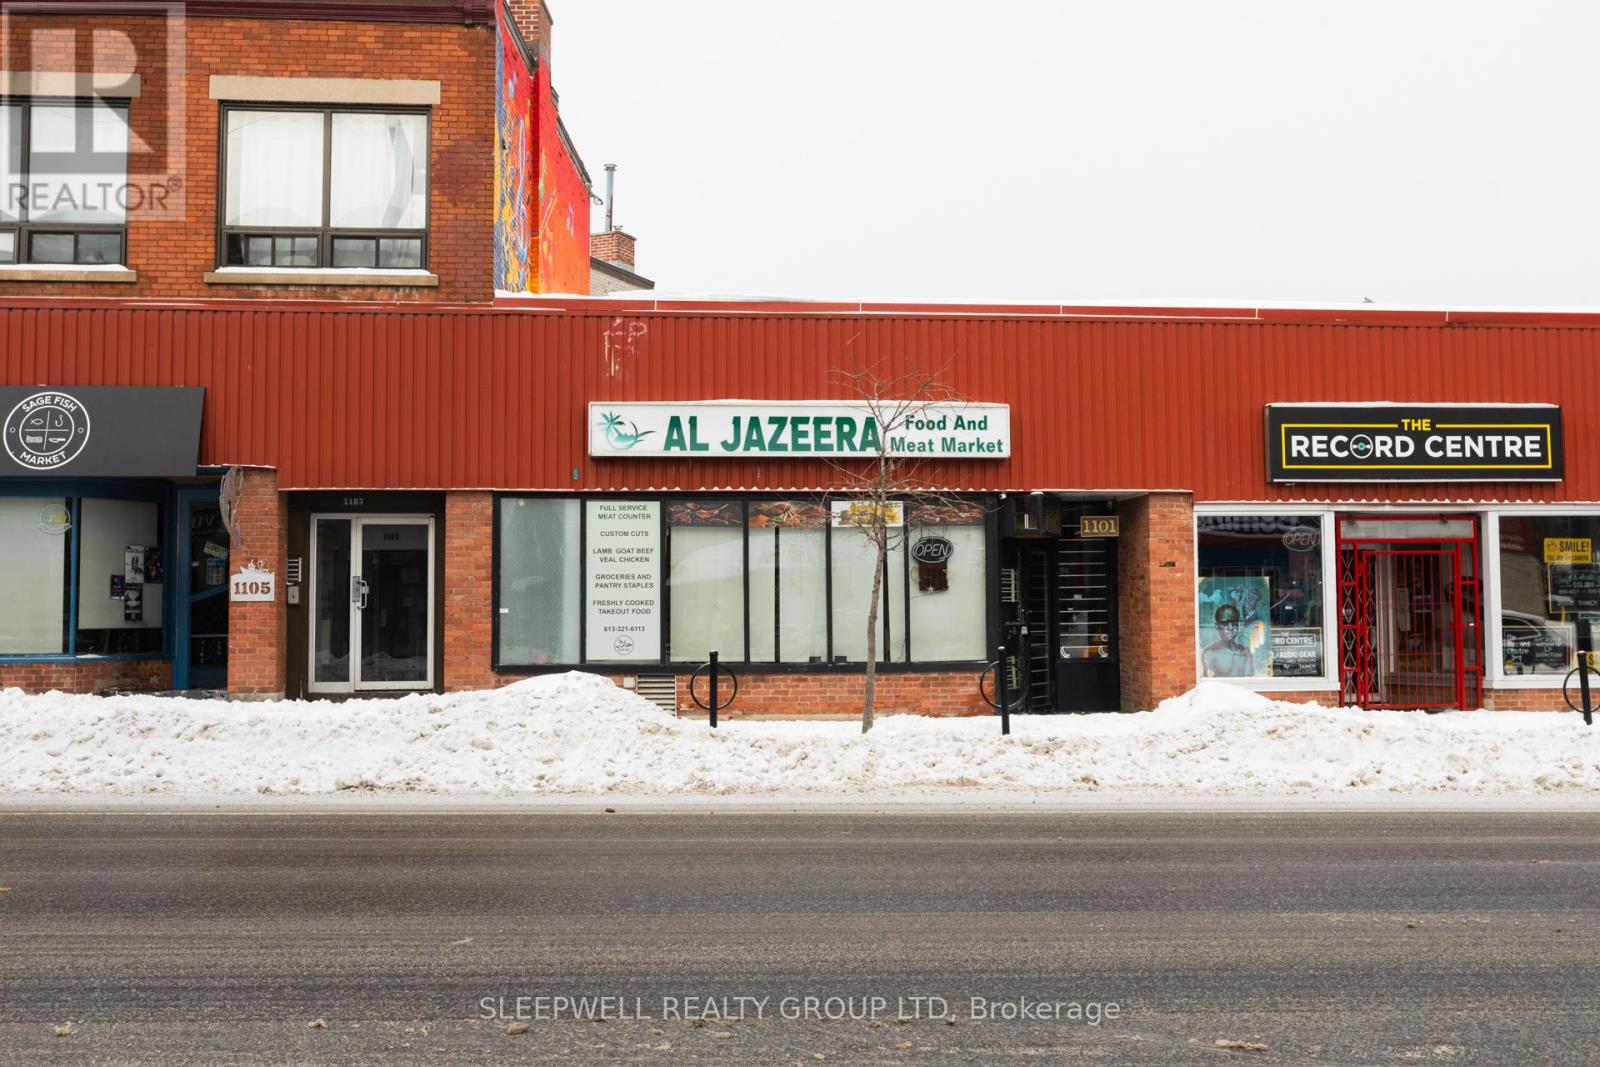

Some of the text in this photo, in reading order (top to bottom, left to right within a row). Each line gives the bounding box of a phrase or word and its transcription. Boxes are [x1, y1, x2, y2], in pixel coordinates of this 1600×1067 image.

[22, 396, 78, 413] SAGE FISH
[904, 415, 988, 431] Food And
[1401, 418, 1432, 431] THE
[663, 416, 882, 452] AL JAZEERA
[890, 437, 1003, 453] Meat Market
[1290, 434, 1542, 459] RECORD CENTRE
[20, 451, 66, 465] MARKET
[1083, 520, 1117, 533] 1101
[1285, 533, 1316, 546] OPEN
[915, 543, 950, 557] OPEN
[1559, 541, 1590, 553] SMILE!
[234, 582, 271, 595] 1105
[1286, 637, 1313, 645] CENTRE
[1299, 650, 1316, 658] GEAR
